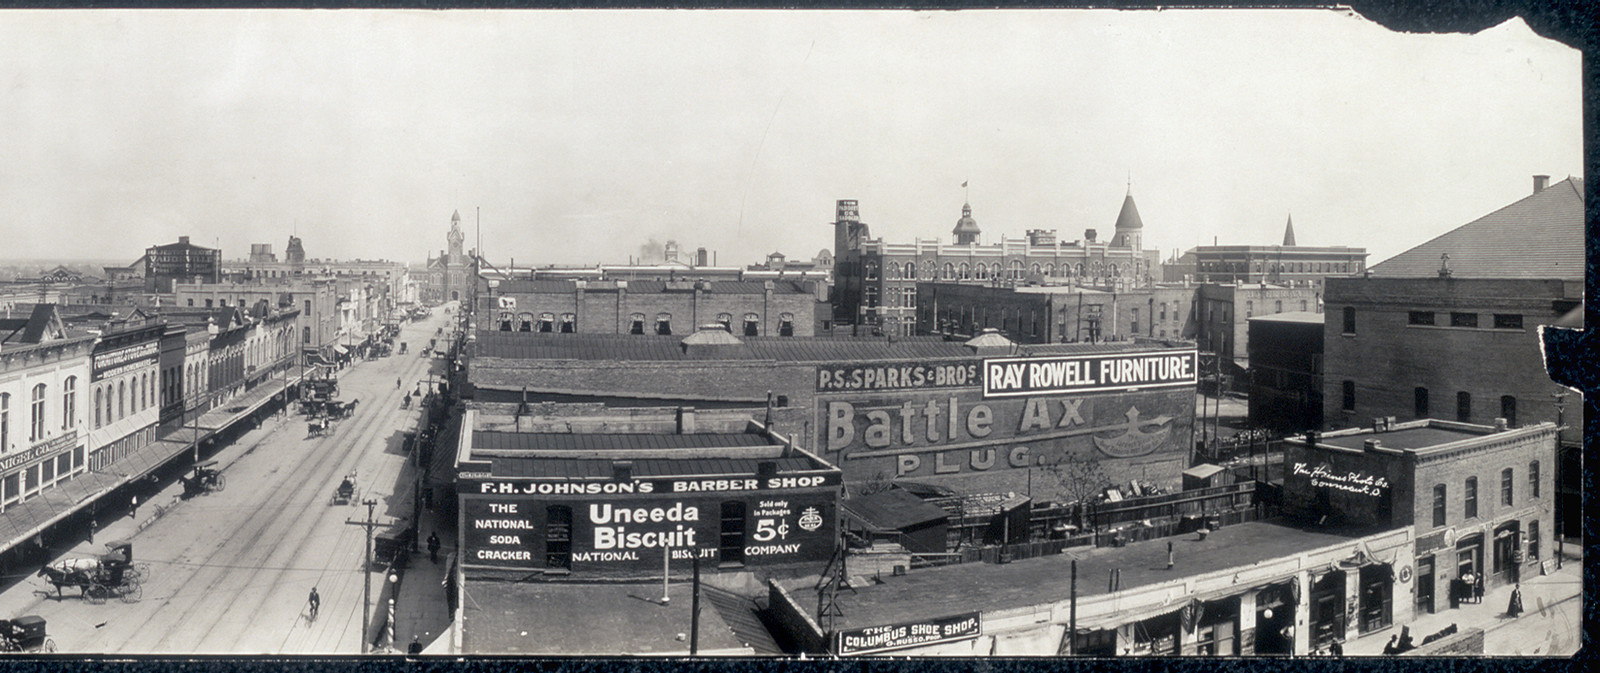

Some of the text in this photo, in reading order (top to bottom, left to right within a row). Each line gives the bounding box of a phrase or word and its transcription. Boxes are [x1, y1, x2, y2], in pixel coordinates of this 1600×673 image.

[990, 355, 1194, 390] RAY ROWELL FURNITURE.
[827, 396, 994, 451] Battle
[897, 446, 1047, 477] PLUG.
[523, 479, 654, 494] JOHNSON'S
[673, 478, 759, 492] BARBER
[767, 475, 826, 489] SHOP
[488, 503, 518, 513] THE
[589, 502, 699, 525] Uneeda
[759, 500, 788, 508] Sold only
[761, 508, 791, 517] Packages
[475, 520, 534, 529] NATIONAL
[489, 535, 521, 545] SODA
[593, 525, 697, 549] Biscuit
[476, 550, 532, 560] CRACKER
[571, 551, 640, 562] NATIONAL
[744, 543, 801, 556] COMPANY
[845, 617, 978, 648] COLUMBUS SHOE SHOP.
[862, 625, 893, 635] THE
